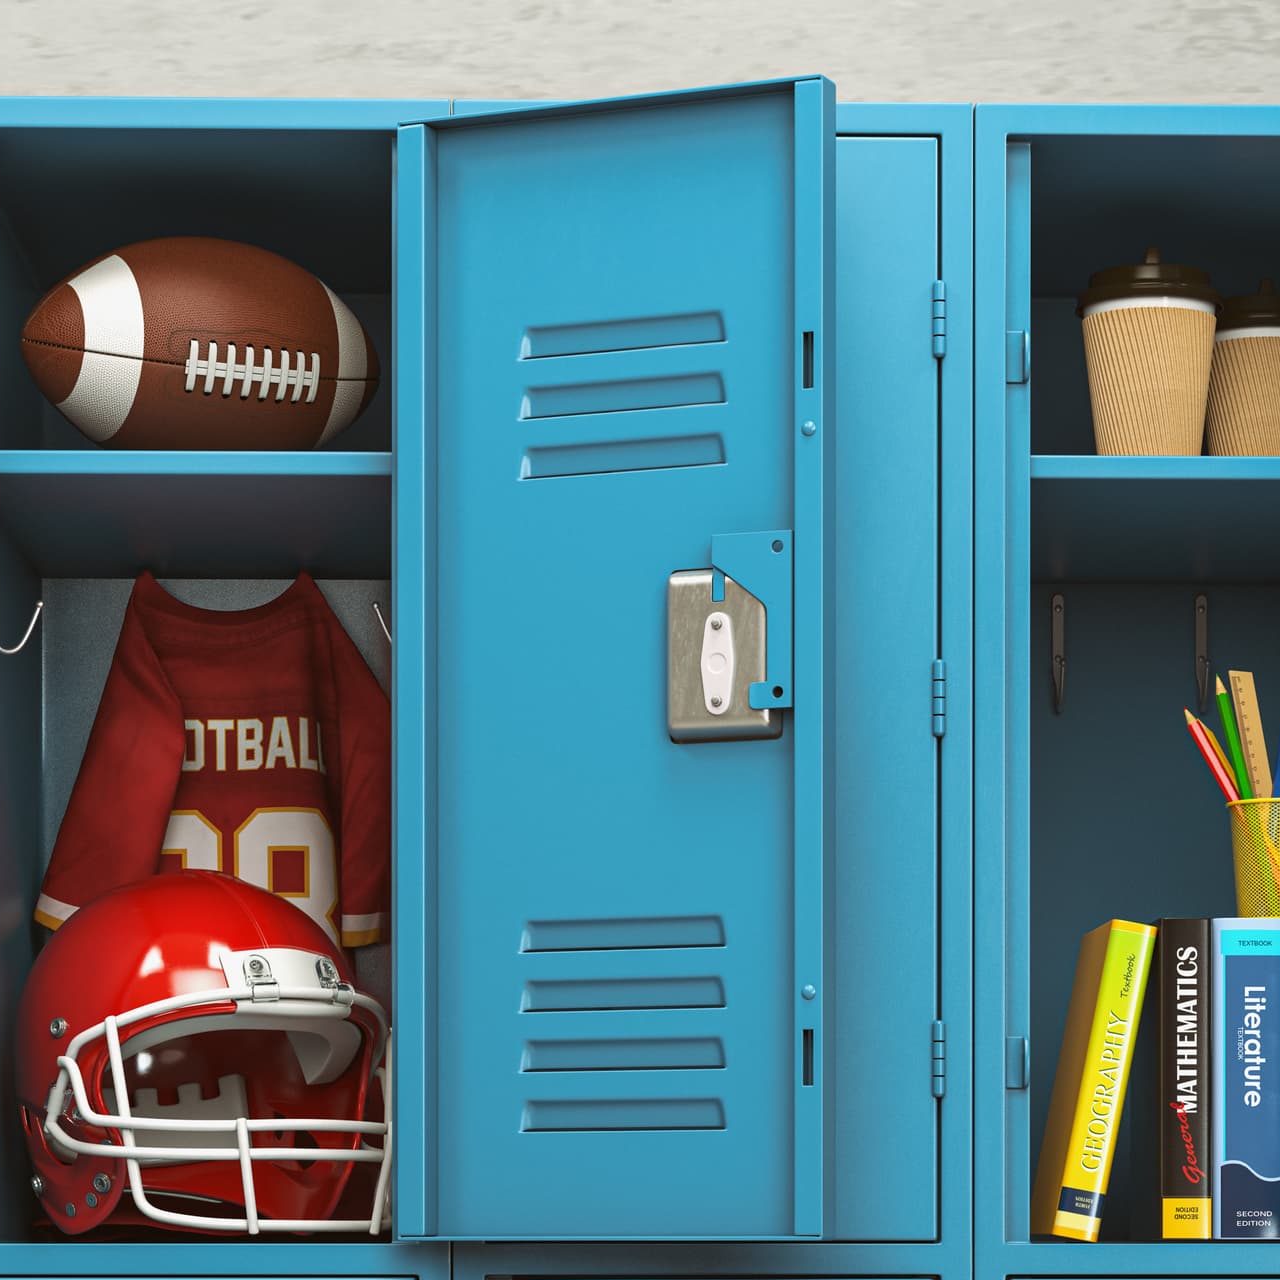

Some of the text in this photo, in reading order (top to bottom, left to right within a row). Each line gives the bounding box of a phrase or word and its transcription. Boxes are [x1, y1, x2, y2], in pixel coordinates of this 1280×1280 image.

[1119, 953, 1136, 999] Textbook
[1176, 946, 1198, 1114] MATHEMATICS
[1080, 1009, 1129, 1173] GEOGRAPHY
[1244, 986, 1267, 1108] Literature
[1169, 1100, 1207, 1184] General
